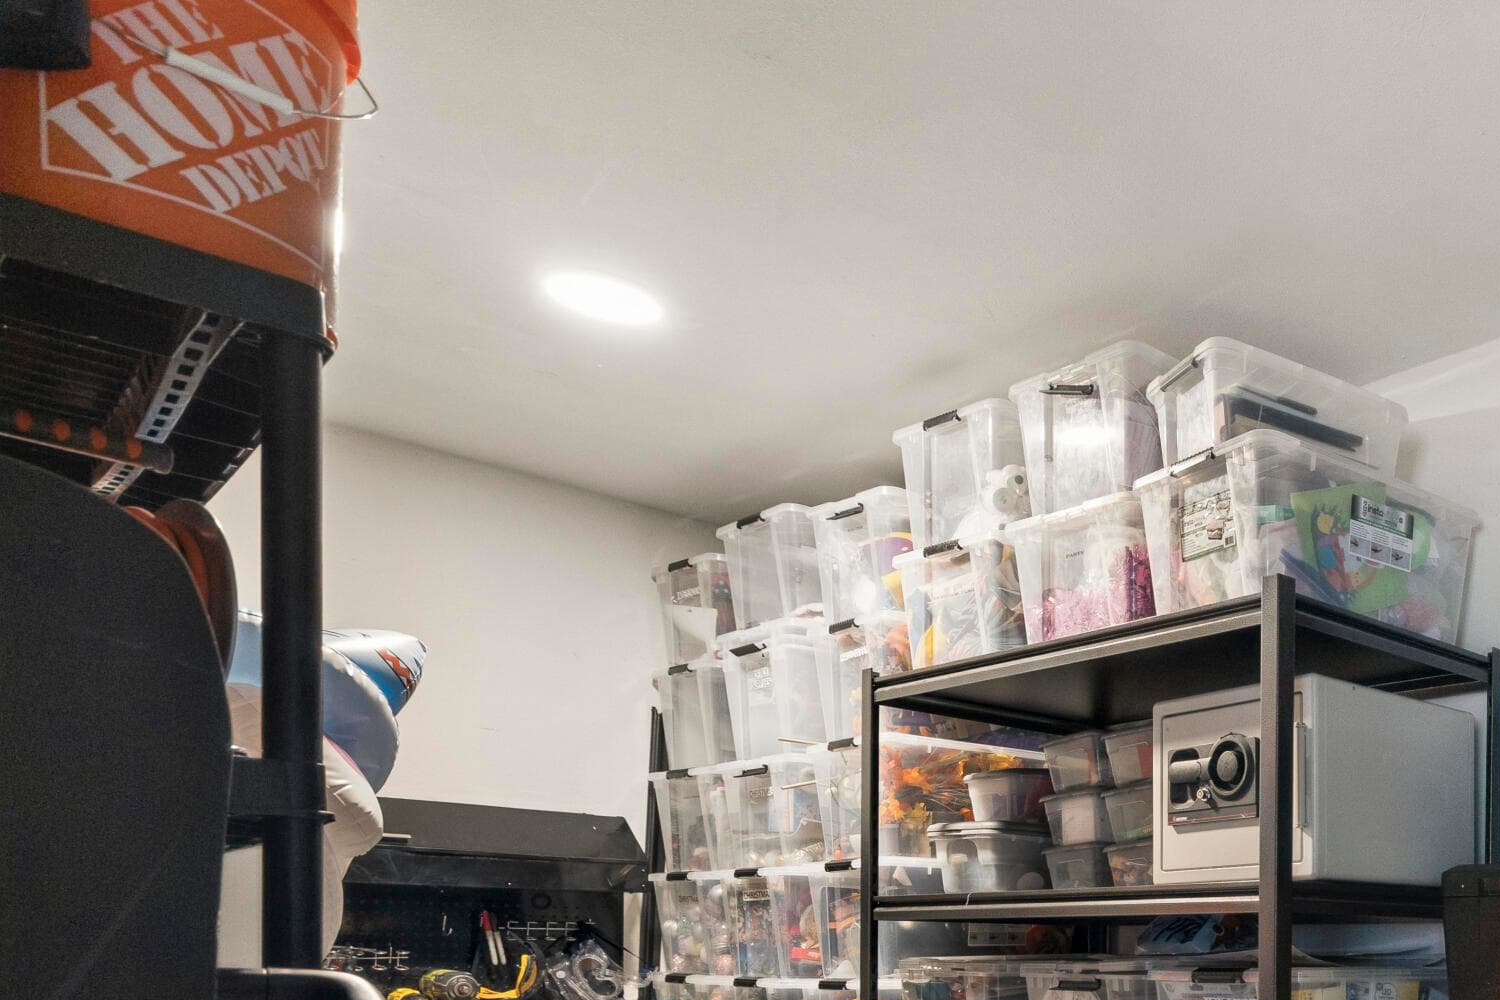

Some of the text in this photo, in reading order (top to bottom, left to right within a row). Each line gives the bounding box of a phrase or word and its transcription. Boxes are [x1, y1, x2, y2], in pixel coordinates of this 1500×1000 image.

[91, 0, 225, 65] THE
[44, 31, 332, 182] HOME
[179, 128, 328, 214] DEPOT
